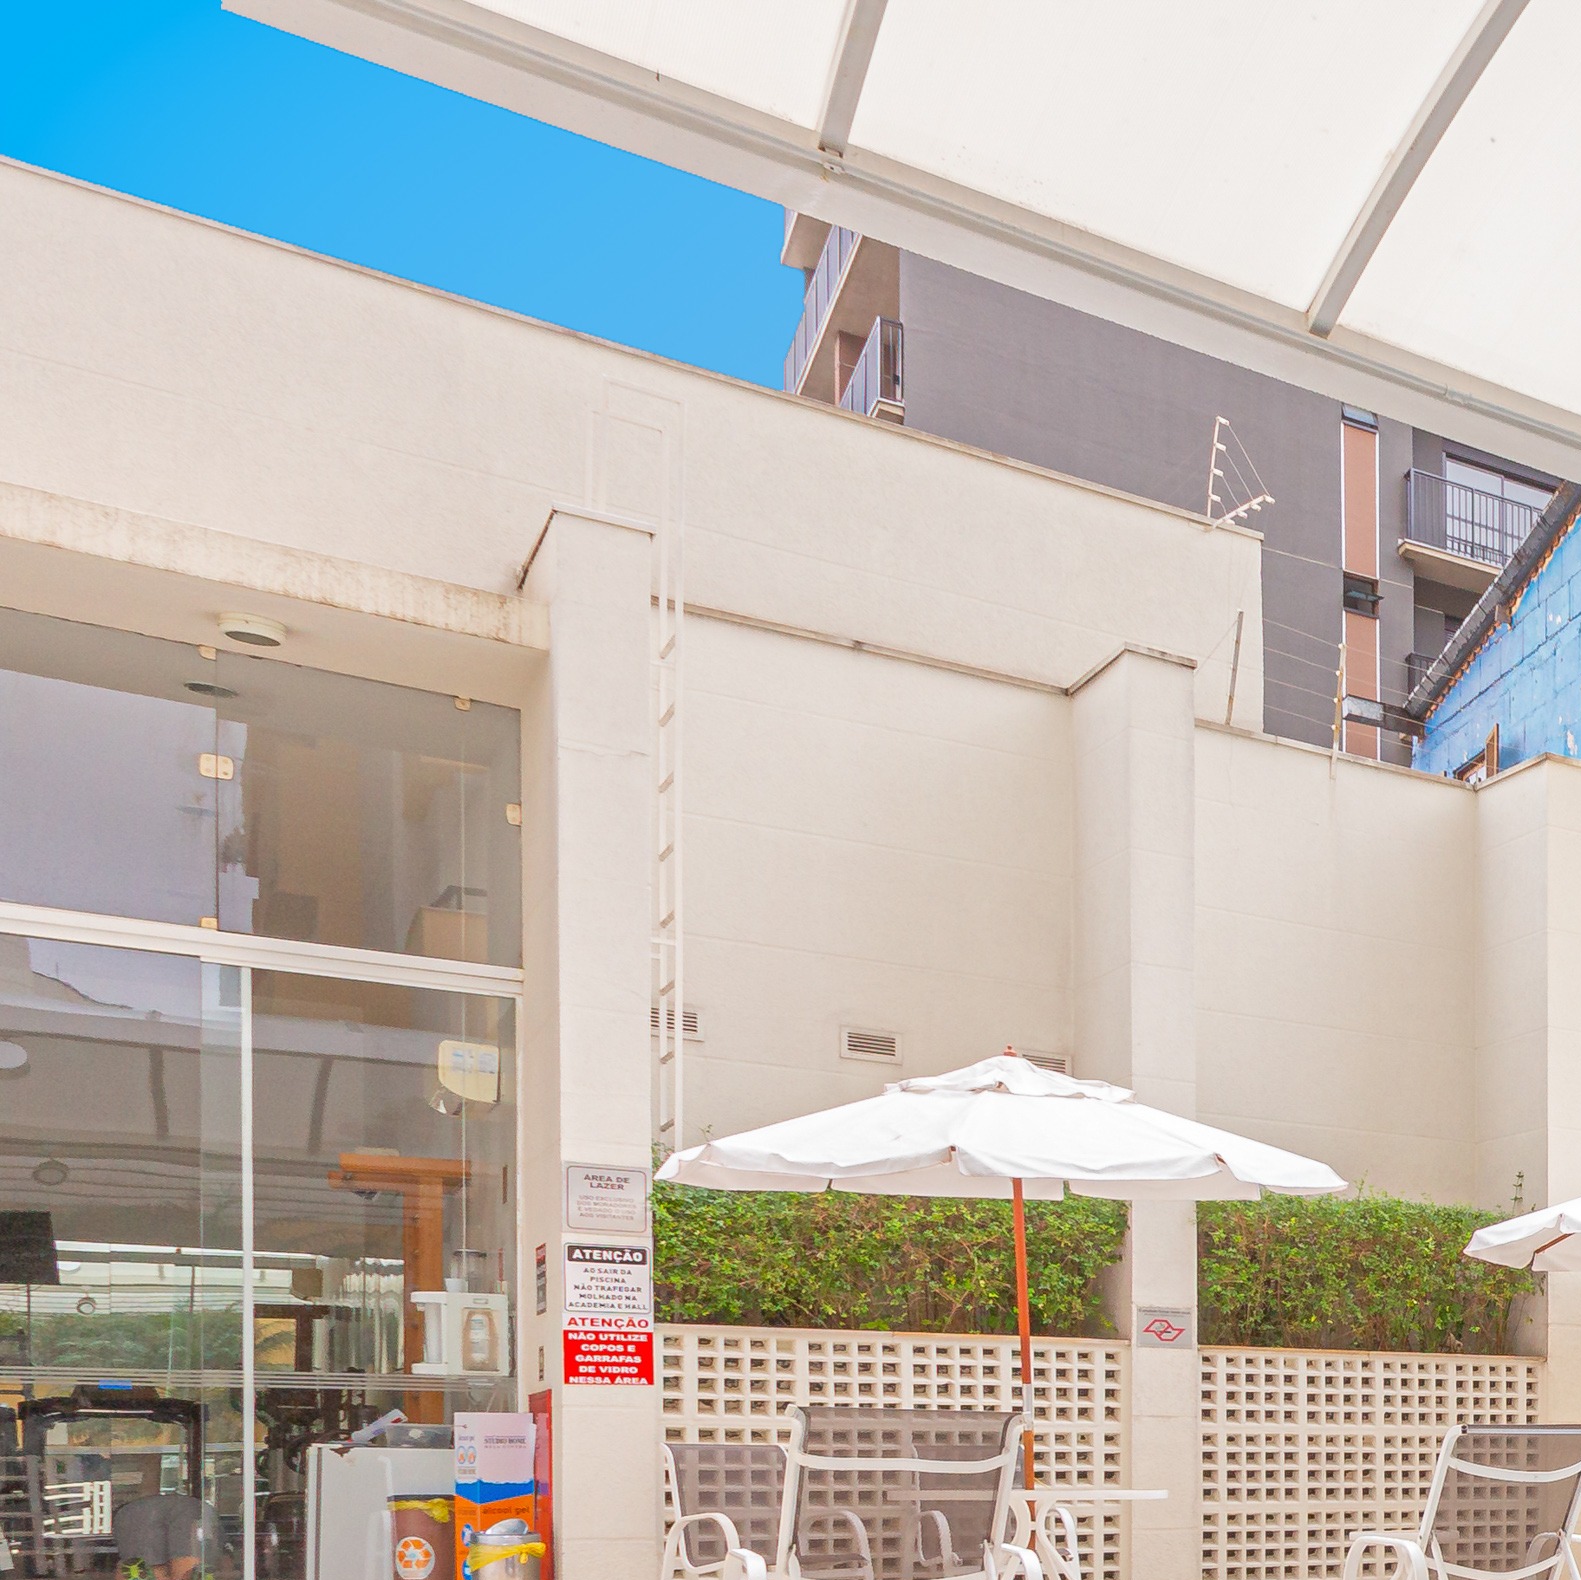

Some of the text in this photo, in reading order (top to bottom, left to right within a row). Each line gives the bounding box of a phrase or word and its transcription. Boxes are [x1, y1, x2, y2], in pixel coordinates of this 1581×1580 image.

[590, 1182, 624, 1190] LAZER
[572, 1248, 643, 1263] ATENÇÃO
[574, 1283, 642, 1293] NÃO TRAFEGAR
[567, 1316, 649, 1329] ATENÇÃO
[568, 1332, 648, 1342] NÃO UTILIZE
[581, 1344, 636, 1353] COPOS E
[575, 1354, 642, 1363] GARRAFAS
[579, 1365, 638, 1374] DE VIDRO
[569, 1376, 648, 1384] NESSA ÁREA
[515, 1506, 530, 1515] gel
